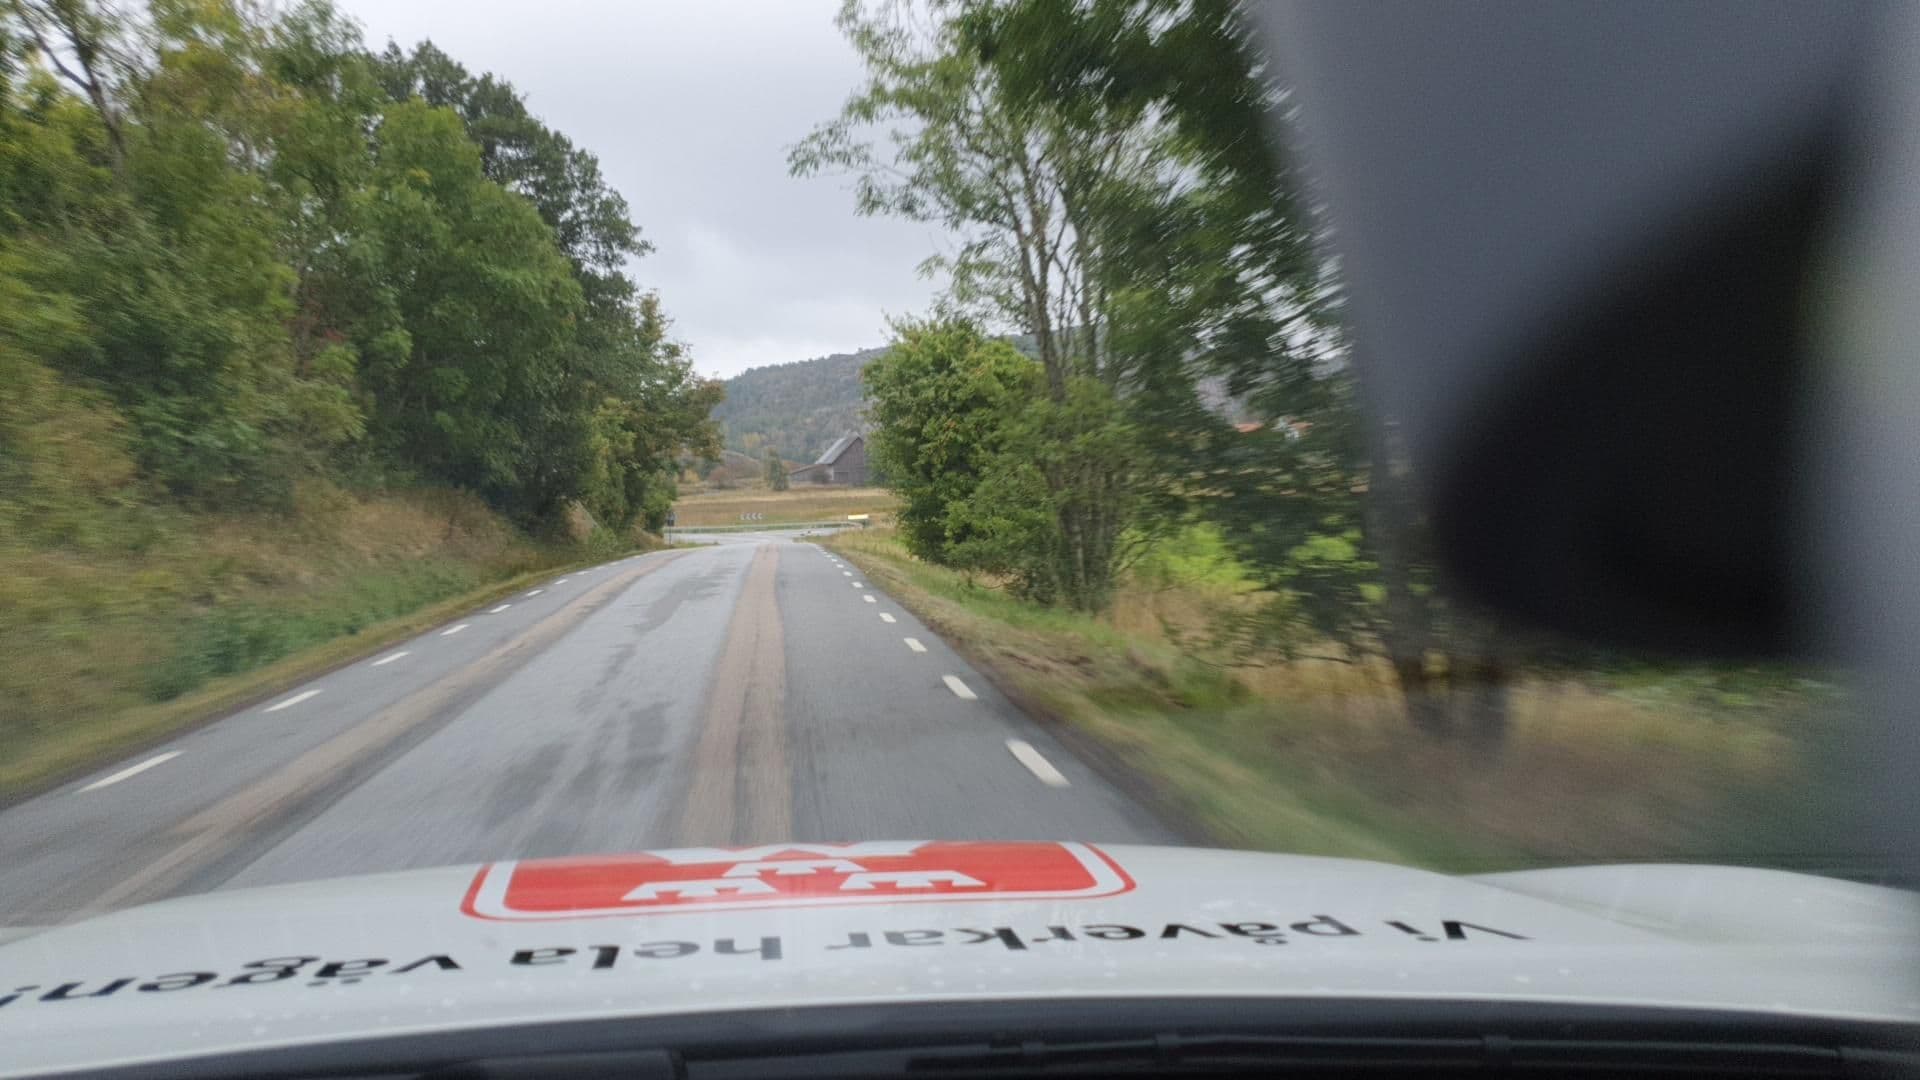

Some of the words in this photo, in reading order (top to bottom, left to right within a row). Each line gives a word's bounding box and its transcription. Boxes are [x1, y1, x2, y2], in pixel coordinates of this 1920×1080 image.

[825, 915, 1361, 950] påverkar
[1385, 920, 1533, 942] Vi
[509, 936, 782, 969] hela
